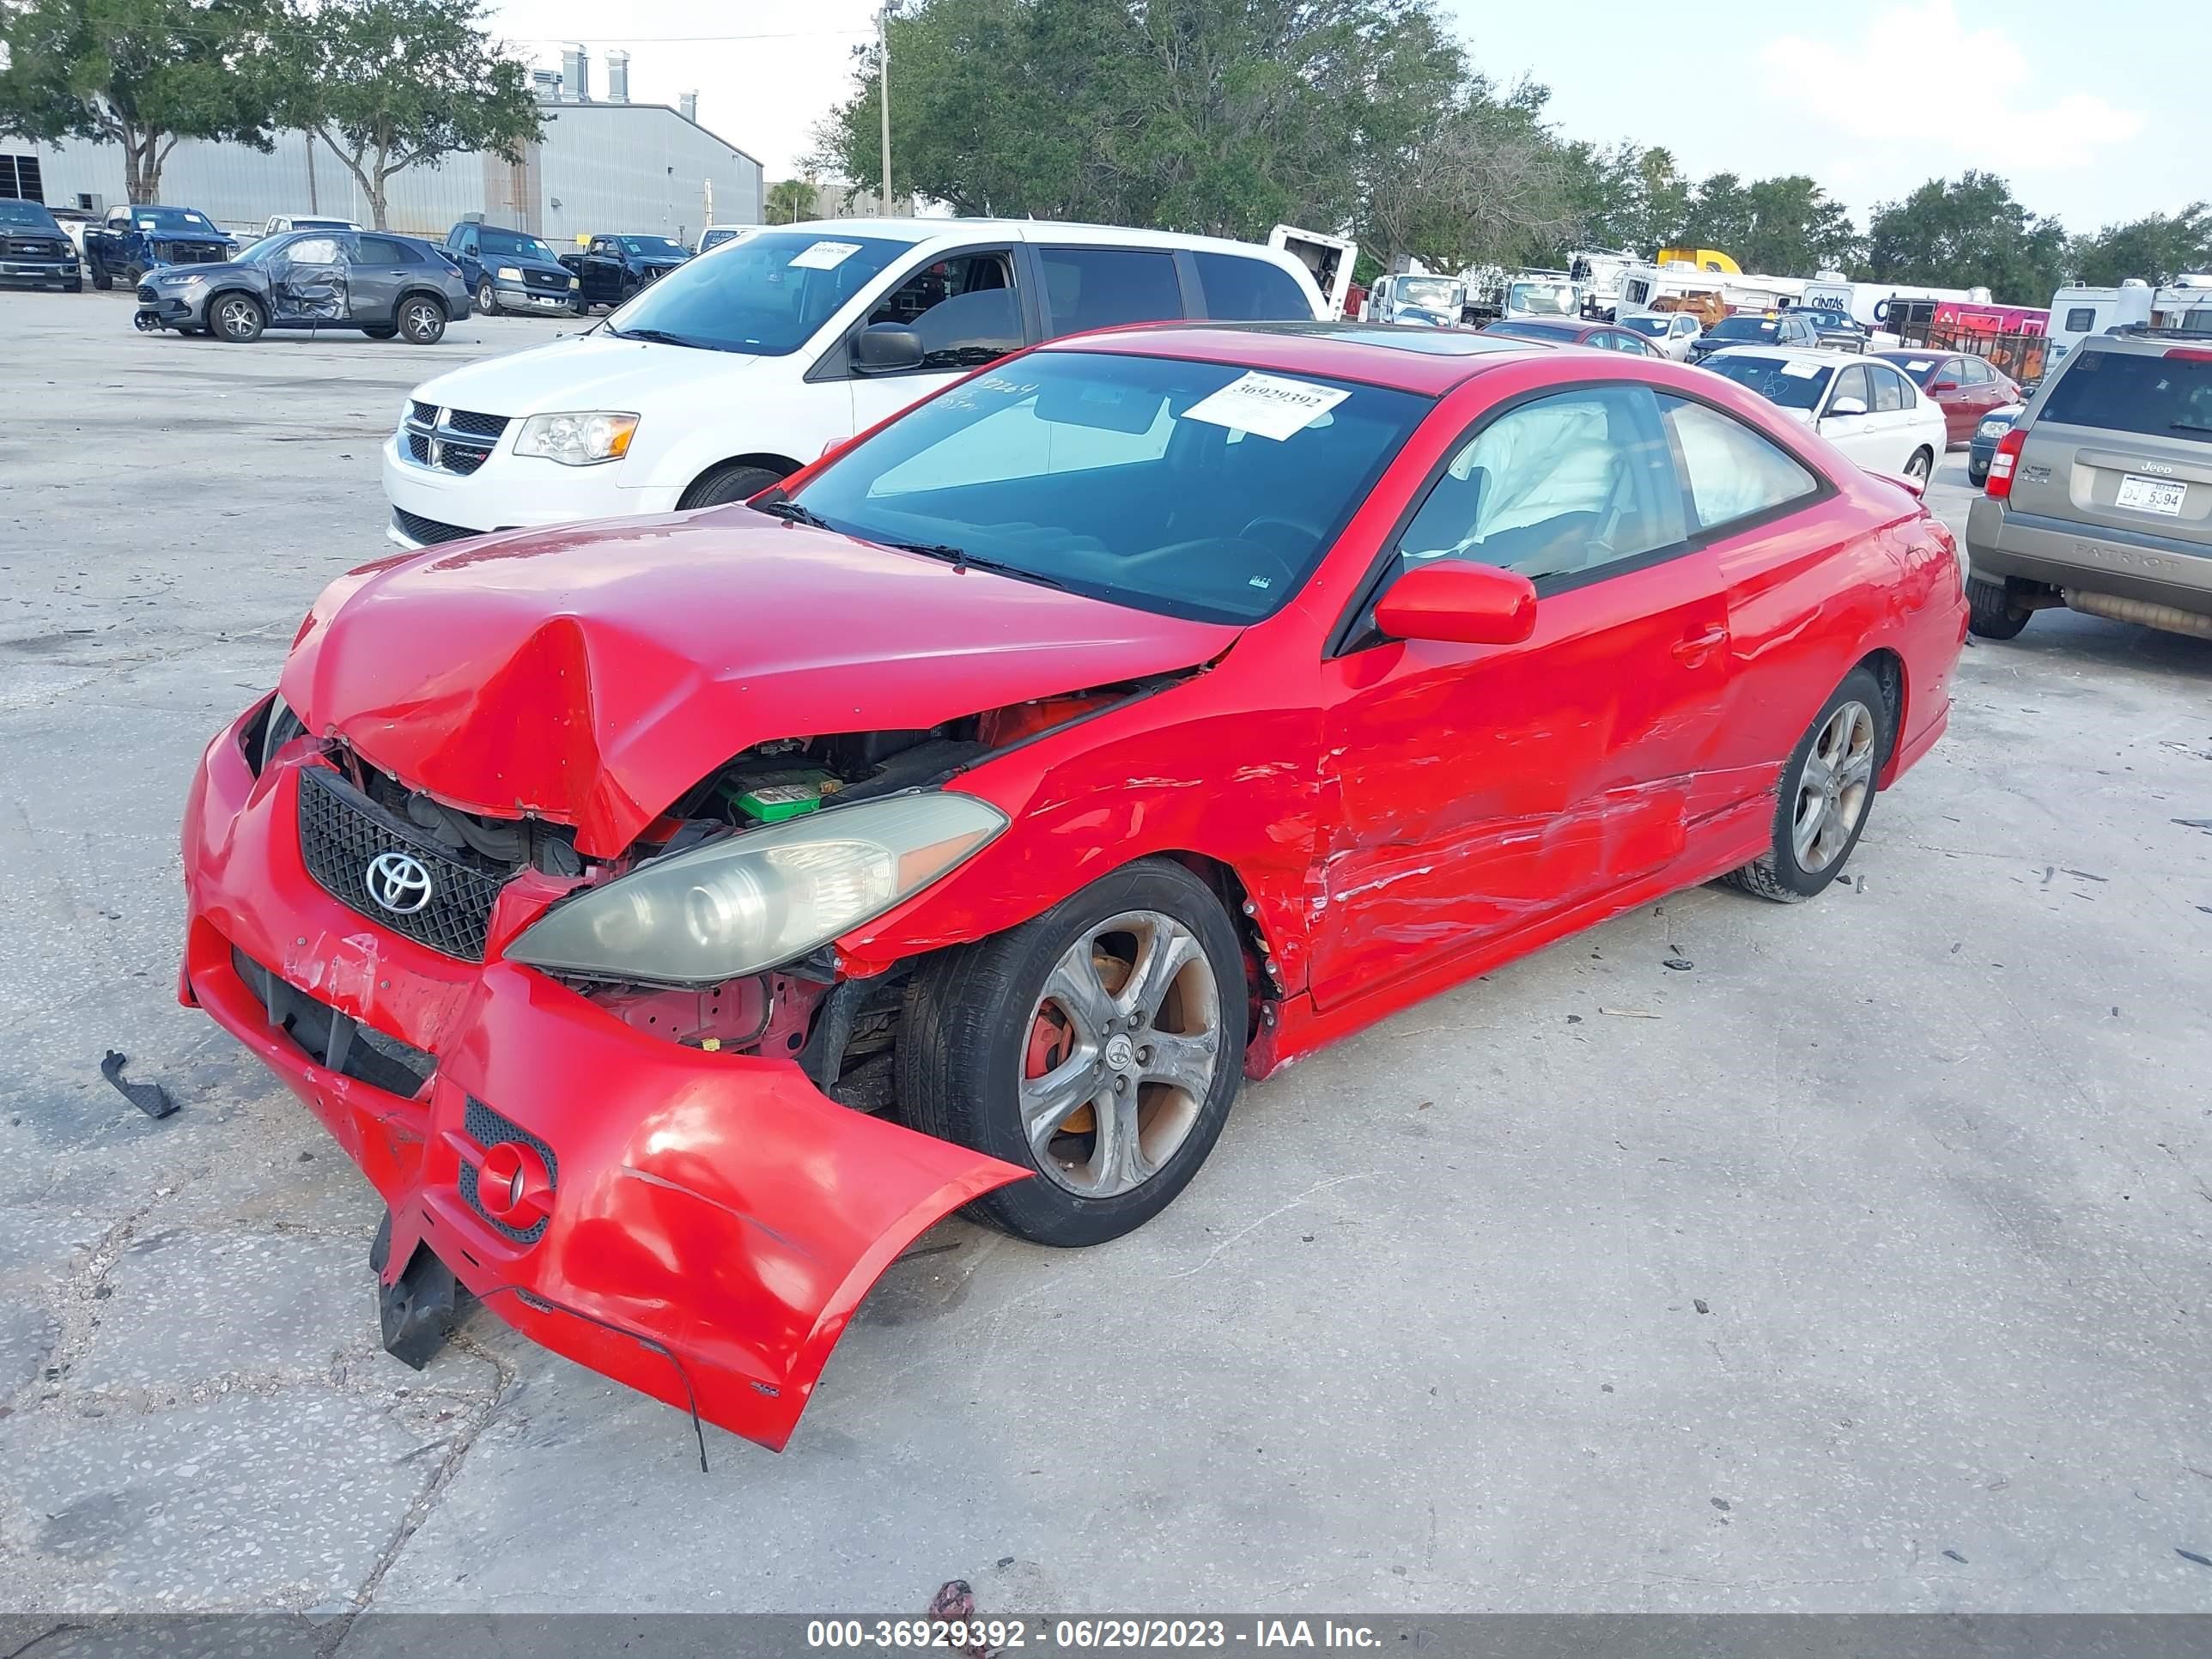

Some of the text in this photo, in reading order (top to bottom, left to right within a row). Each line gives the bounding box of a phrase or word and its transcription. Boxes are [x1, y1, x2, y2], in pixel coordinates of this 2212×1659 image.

[1811, 293, 1844, 310] CINTAS
[1232, 384, 1322, 408] 36929392
[2141, 461, 2172, 475] Jeep
[2072, 543, 2181, 570] PATRIOT
